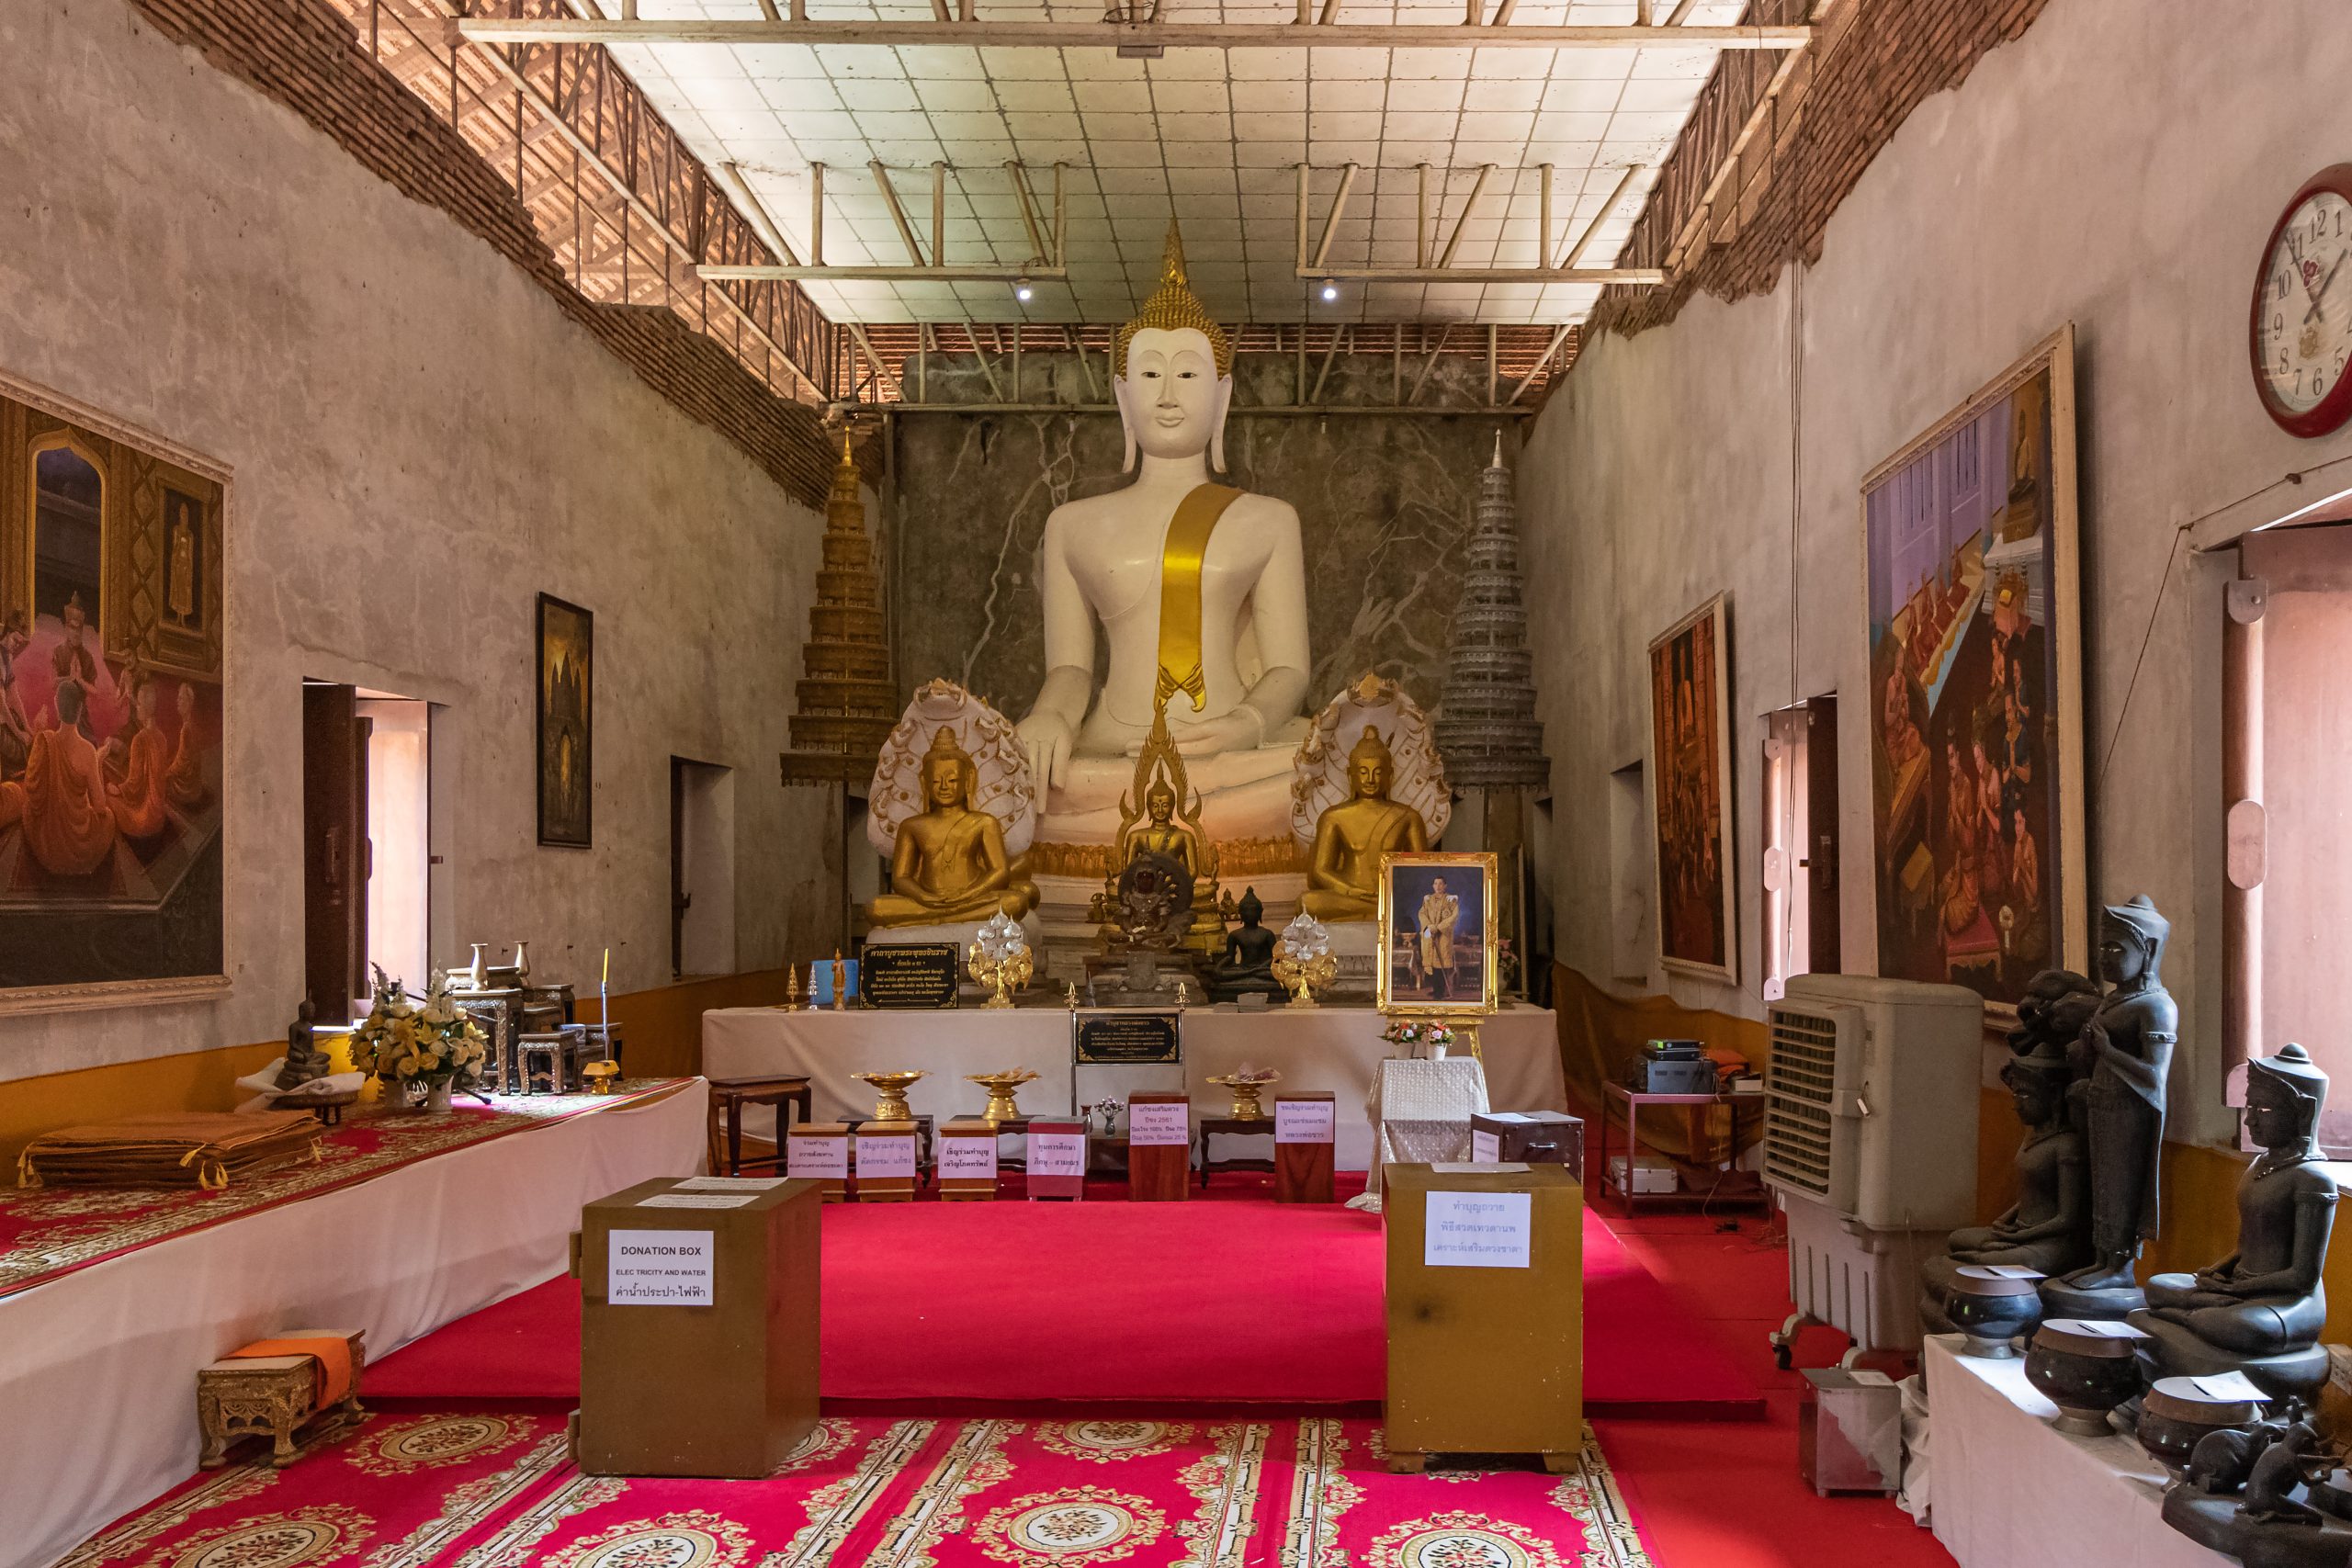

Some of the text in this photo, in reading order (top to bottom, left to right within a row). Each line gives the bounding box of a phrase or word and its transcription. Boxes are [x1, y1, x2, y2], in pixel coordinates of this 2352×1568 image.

[2309, 209, 2327, 244] 12
[2335, 209, 2343, 238] 1
[2289, 231, 2304, 265] 11
[2277, 269, 2291, 300] 10
[2273, 312, 2283, 340] 9
[2278, 347, 2289, 375] 8
[2335, 346, 2345, 376] 5
[2294, 368, 2301, 395] 7
[2312, 367, 2323, 396] 6
[946, 1147, 989, 1156] เชิญร่วมทำบุญ
[1453, 1201, 1505, 1213] ทำบุญถวาย
[1441, 1221, 1516, 1233] พิธีสวดเทวดานพ
[621, 1247, 702, 1256] DONATION BOX
[616, 1281, 706, 1297] ค่าน้ำประปา-ไฟฟ้า
